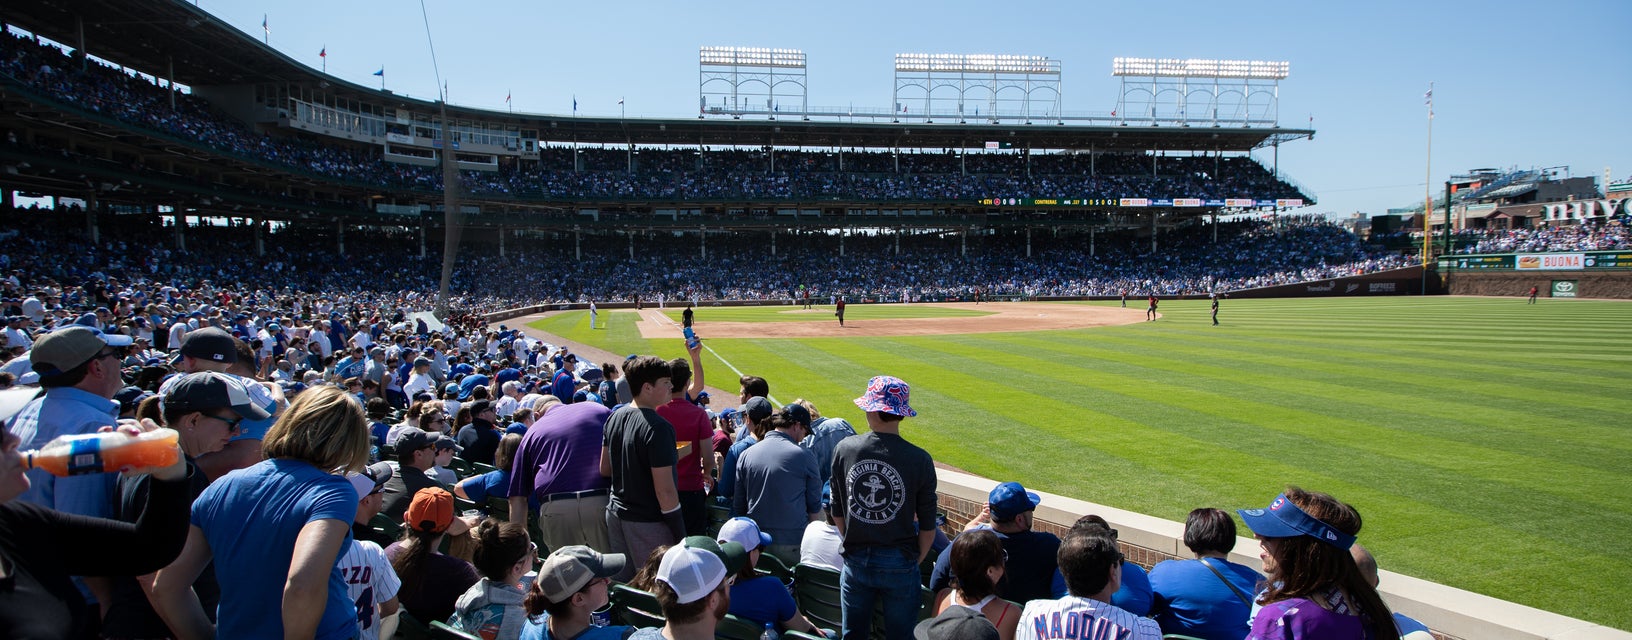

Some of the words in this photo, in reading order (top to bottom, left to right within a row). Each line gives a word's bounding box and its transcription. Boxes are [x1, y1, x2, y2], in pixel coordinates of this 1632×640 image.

[1543, 256, 1580, 267] BUONA
[848, 463, 878, 484] VIRGINIA
[880, 466, 901, 491] BEACH
